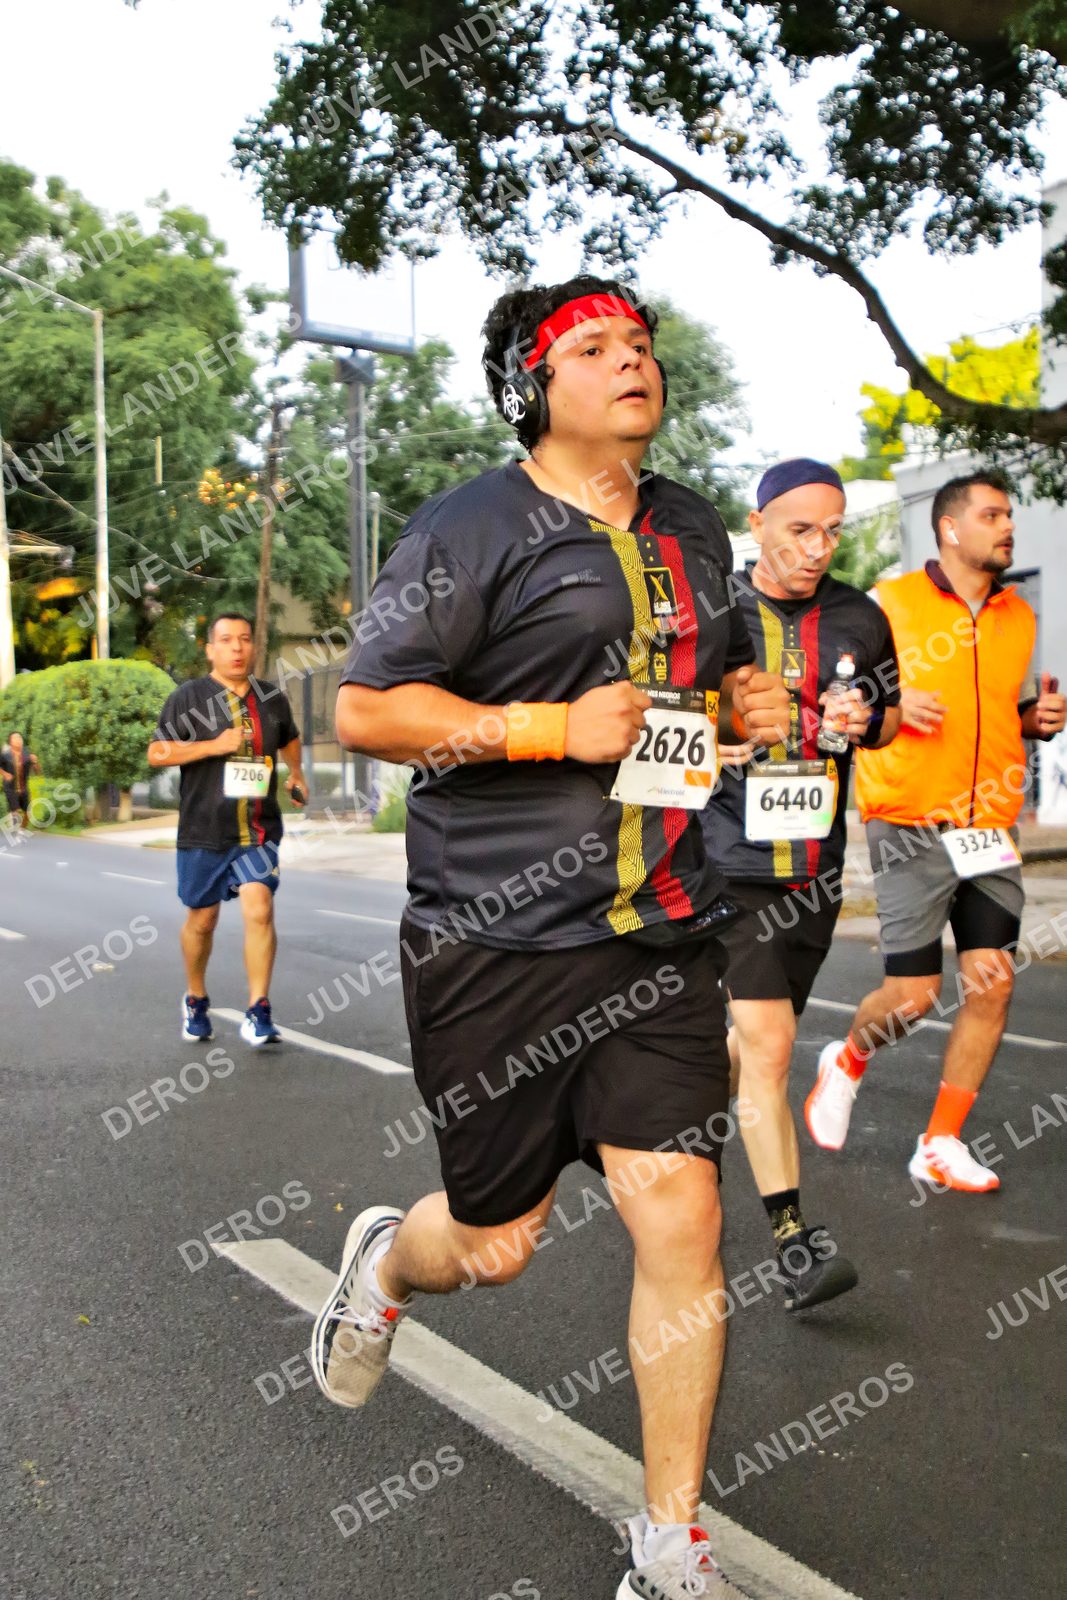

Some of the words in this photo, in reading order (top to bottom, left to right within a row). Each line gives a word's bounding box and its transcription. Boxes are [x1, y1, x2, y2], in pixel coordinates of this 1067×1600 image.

[635, 724, 706, 767] 2626
[233, 767, 264, 782] 7206
[760, 786, 823, 812] 6440
[956, 827, 1002, 854] 3324
